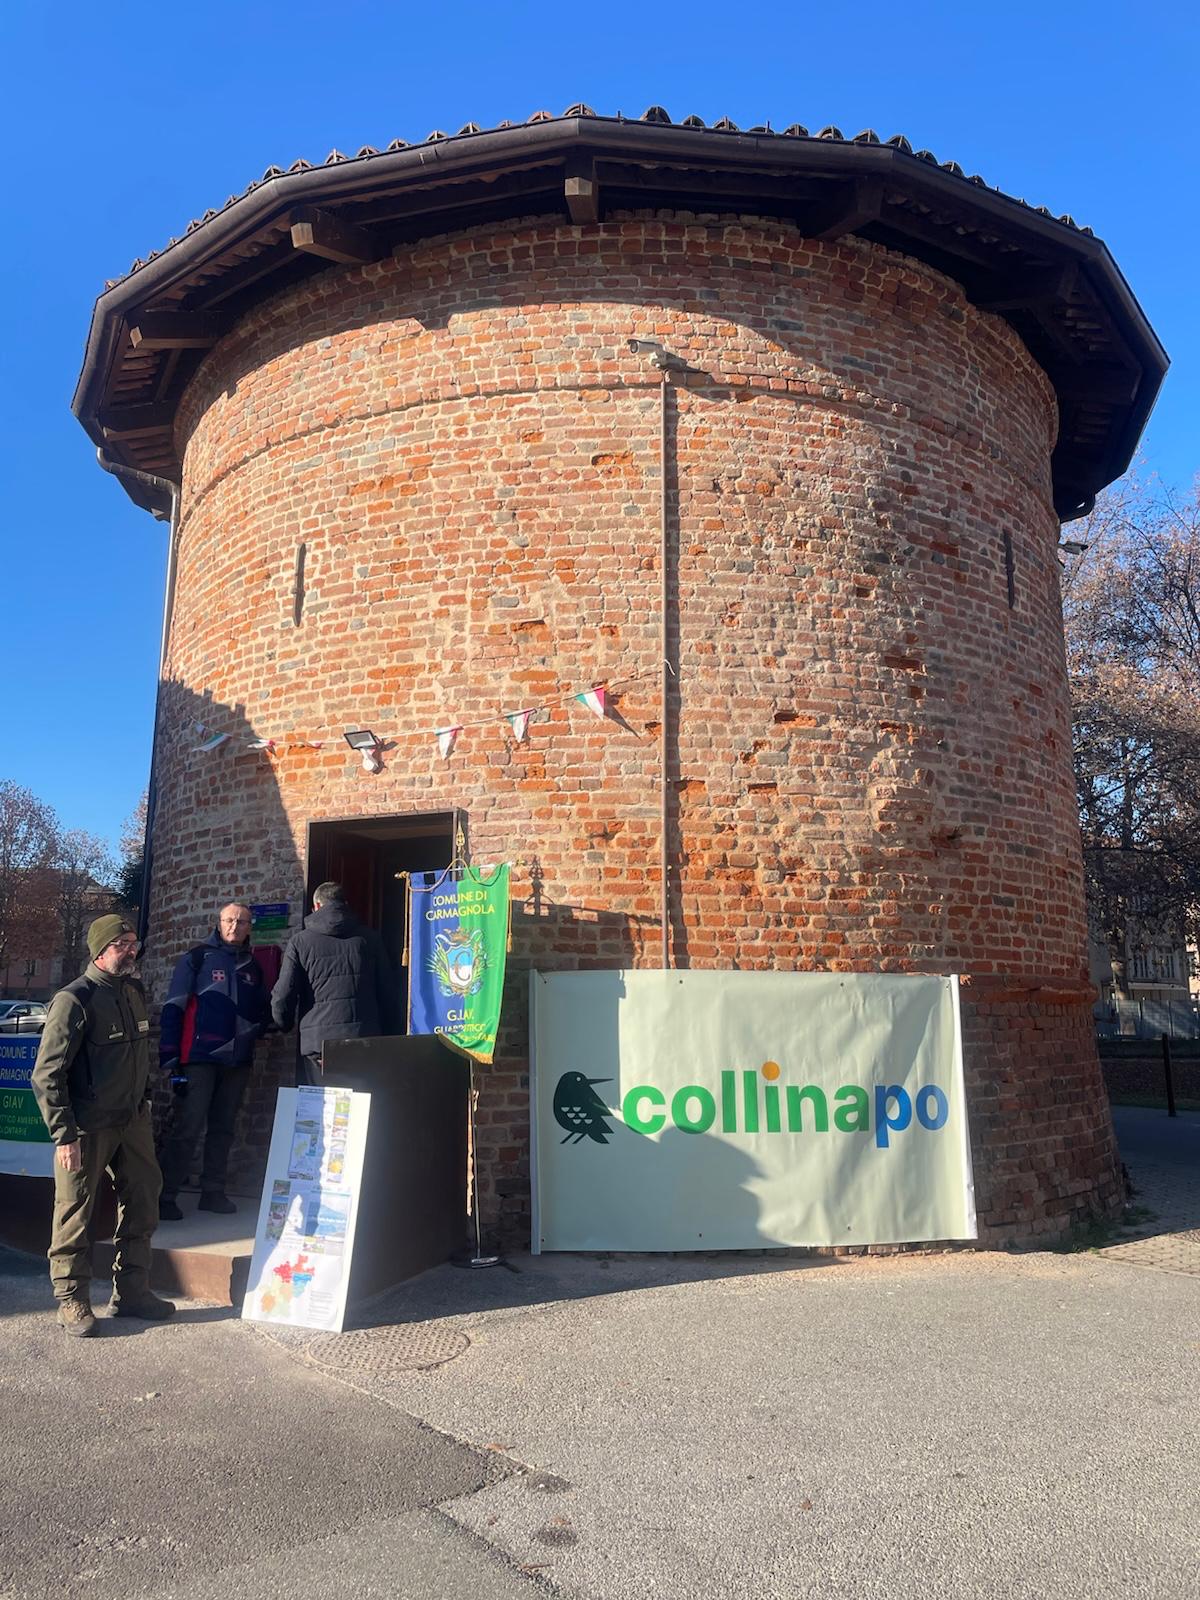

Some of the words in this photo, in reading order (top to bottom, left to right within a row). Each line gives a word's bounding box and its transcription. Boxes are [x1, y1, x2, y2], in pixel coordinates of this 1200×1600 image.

[475, 890, 487, 901] DI
[31, 1046, 38, 1059] D
[0, 1067, 33, 1081] RMAGNO
[2, 1095, 24, 1109] GIAV
[623, 1061, 949, 1148] collinapo
